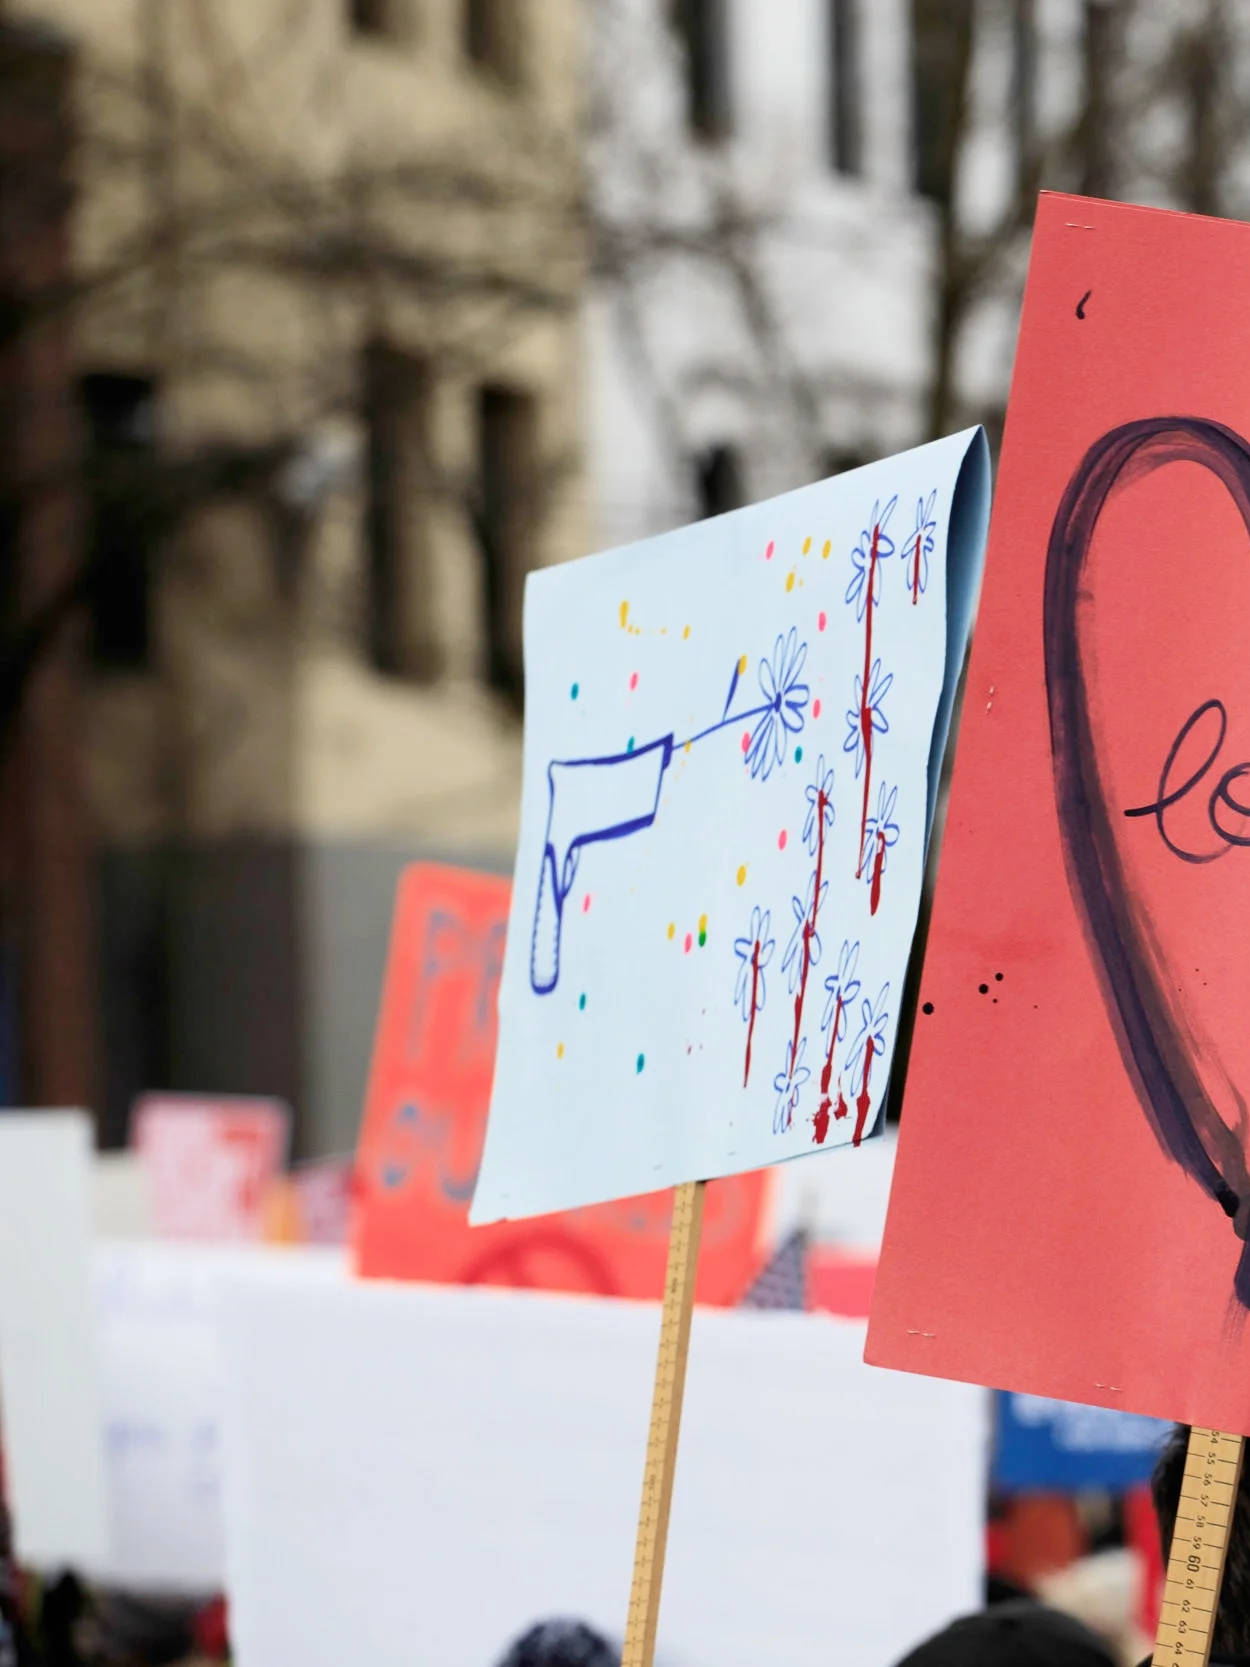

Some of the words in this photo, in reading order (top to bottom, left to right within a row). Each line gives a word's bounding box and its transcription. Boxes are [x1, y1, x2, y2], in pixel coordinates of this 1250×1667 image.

[1210, 1430, 1220, 1444] 54
[1207, 1451, 1216, 1465] 55
[1203, 1473, 1212, 1486] 56
[1200, 1494, 1209, 1507] 57
[1196, 1515, 1205, 1528] 58
[1193, 1536, 1202, 1550] 59
[1186, 1555, 1201, 1573] 60
[1185, 1578, 1194, 1590] 61
[1181, 1600, 1191, 1613] 62
[1178, 1620, 1187, 1634] 63
[1174, 1641, 1184, 1655] 64
